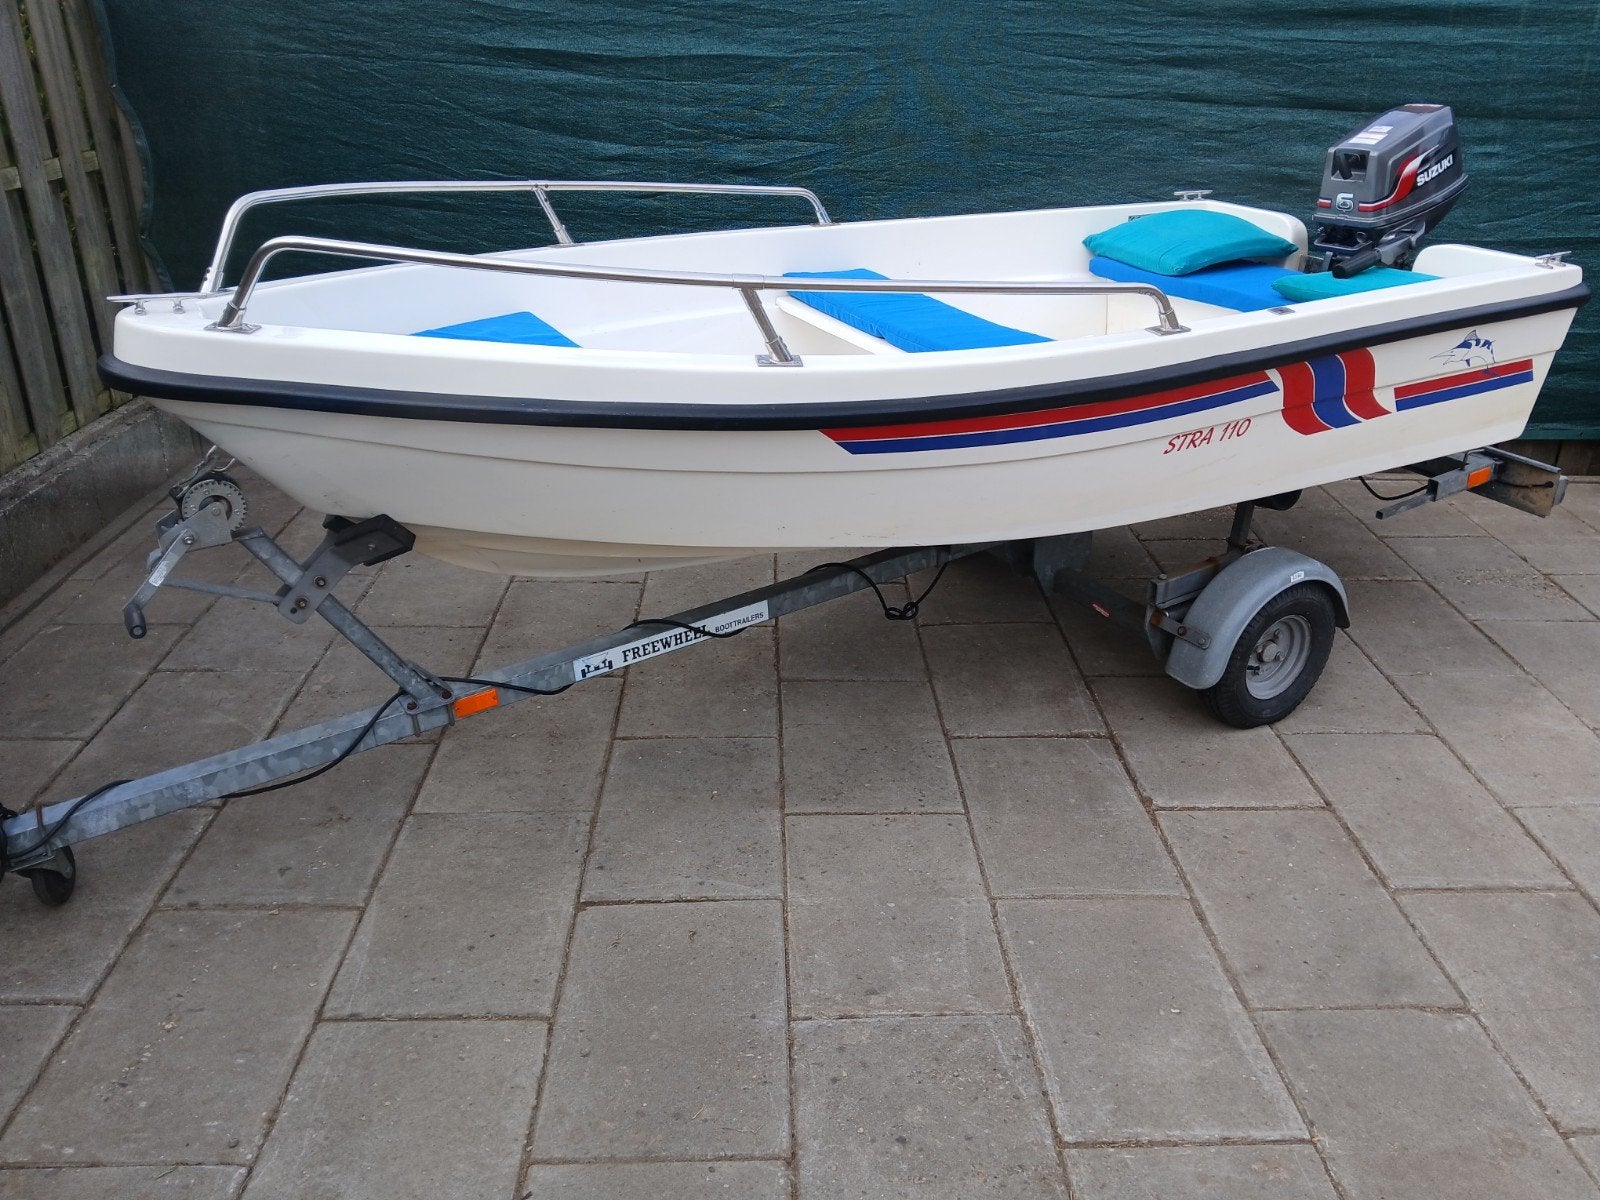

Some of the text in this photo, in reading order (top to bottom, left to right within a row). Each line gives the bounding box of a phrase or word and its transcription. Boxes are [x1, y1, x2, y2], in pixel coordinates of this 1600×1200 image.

[1416, 154, 1454, 187] SUZUKI
[1336, 192, 1354, 212] 6
[1163, 418, 1252, 455] STRA 110
[714, 611, 764, 633] BOOTTRAILERS
